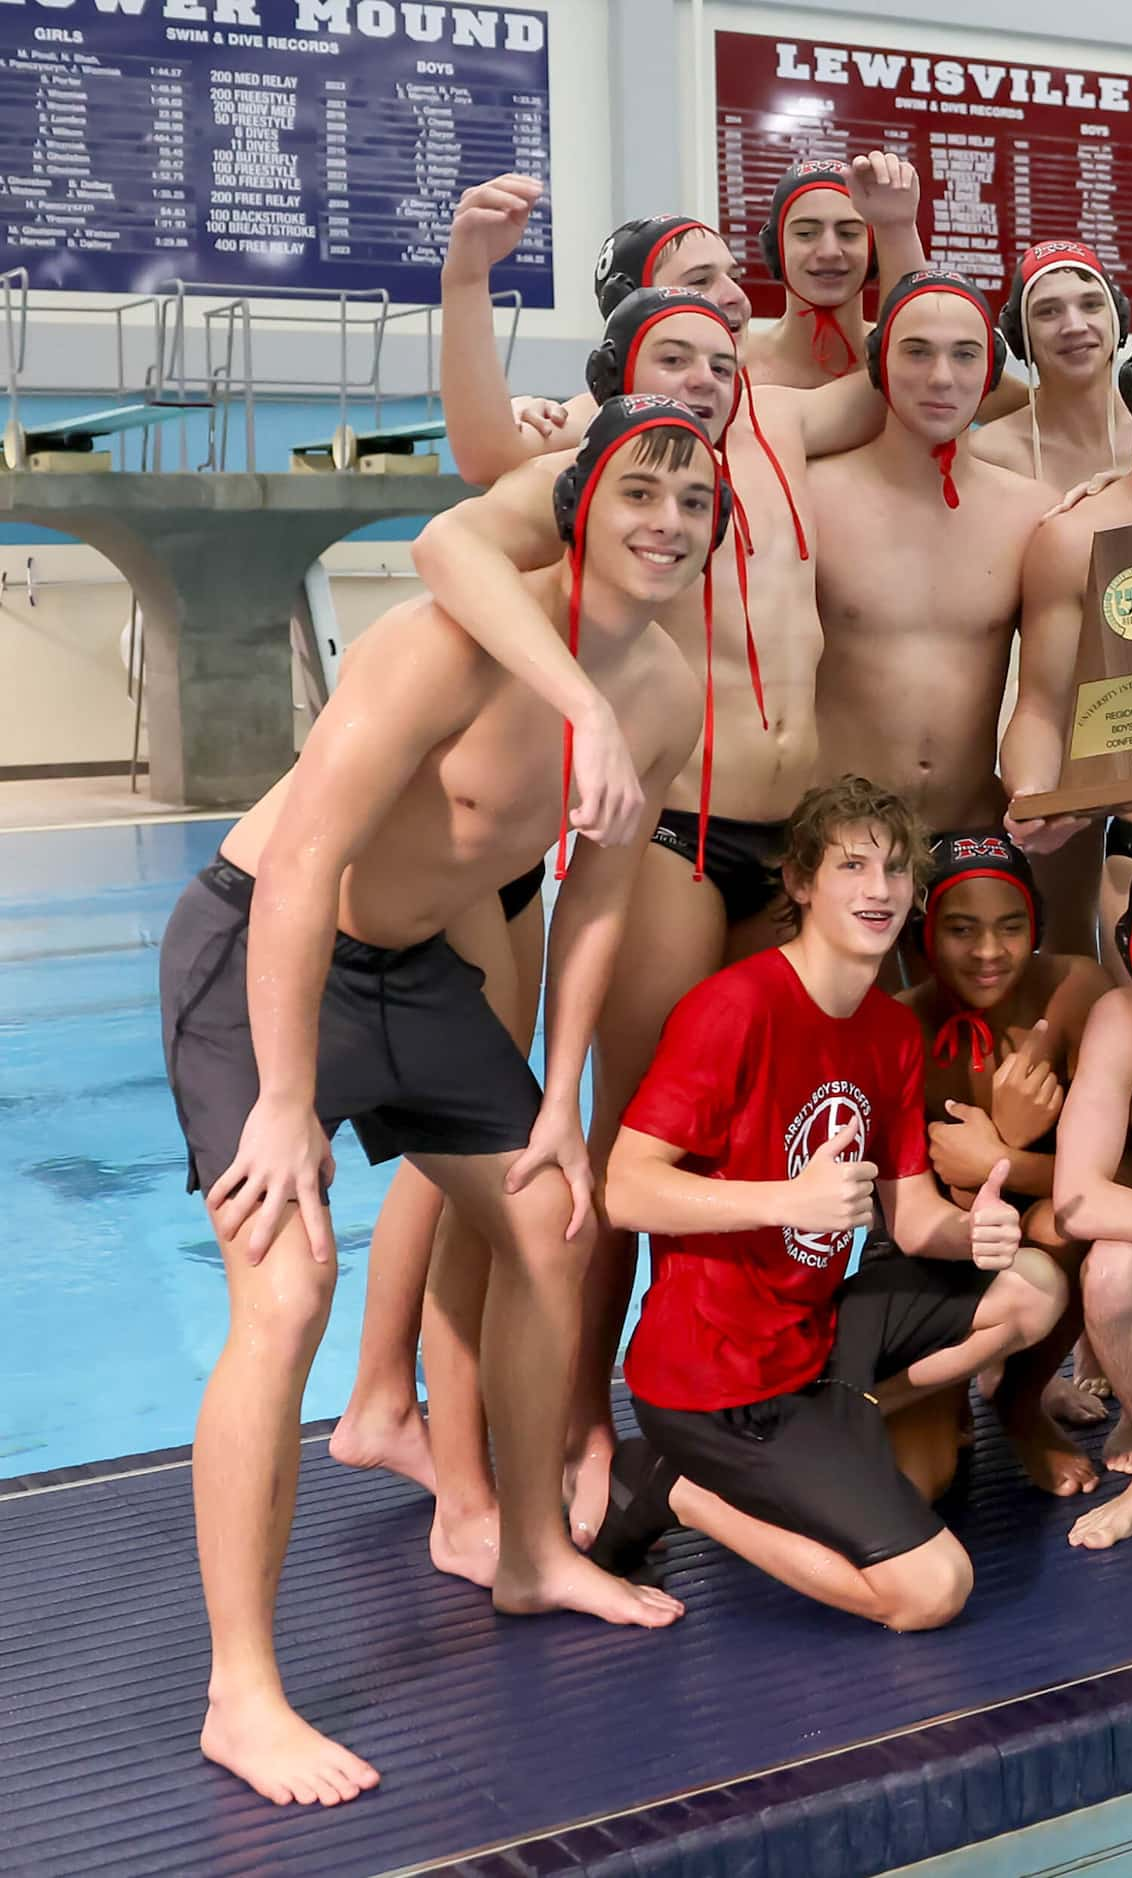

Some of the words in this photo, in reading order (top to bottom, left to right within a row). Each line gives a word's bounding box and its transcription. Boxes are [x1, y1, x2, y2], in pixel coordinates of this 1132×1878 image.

[295, 0, 545, 52] MOUND
[34, 27, 84, 43] GIRLS
[166, 27, 208, 42] SWIM
[213, 32, 223, 44] &
[228, 33, 263, 47] DIVE
[267, 36, 339, 54] RECORDS
[416, 60, 454, 76] BOYS
[210, 70, 232, 83] 200
[234, 72, 259, 85] MED
[262, 74, 298, 89] RELAY
[776, 42, 1130, 113] LEWISVILLE
[210, 87, 232, 100] 200
[234, 89, 296, 106] FREESTYLE
[214, 100, 235, 113] 200
[271, 105, 296, 118] MED
[214, 113, 229, 125] 50
[232, 113, 295, 130] FREESTYLE
[245, 127, 279, 140] DIVES
[231, 138, 242, 150] 11
[246, 139, 280, 152] DIVES
[213, 150, 233, 162] 100
[236, 151, 298, 166] BUTTERFLY
[212, 161, 232, 174] 100
[234, 163, 297, 178] FREESTYLE
[214, 174, 236, 187] 500
[239, 176, 301, 190] FREESTYLE
[210, 191, 232, 203] 200
[235, 192, 262, 206] FREE
[265, 194, 301, 208] RELAY
[209, 209, 230, 222] 100
[232, 210, 306, 226] BACKSTROKE
[205, 221, 226, 233] 100
[228, 221, 316, 238] BREASTSTROKE
[214, 238, 237, 251] 400
[239, 239, 267, 253] FREE
[270, 240, 304, 255] RELAY
[1078, 689, 1118, 727] UNIVERSITY
[841, 1080, 872, 1116] PYOFFS
